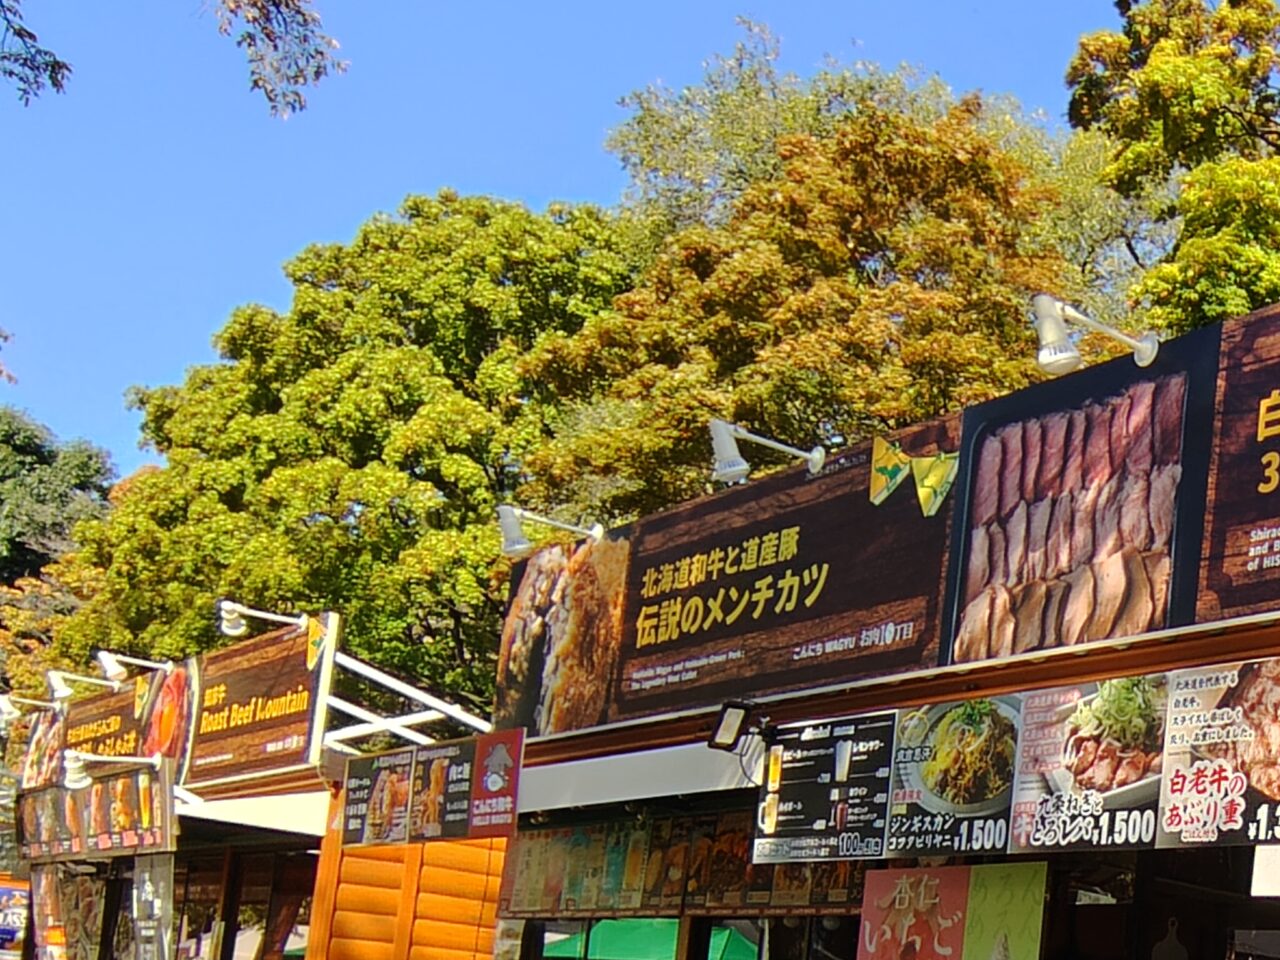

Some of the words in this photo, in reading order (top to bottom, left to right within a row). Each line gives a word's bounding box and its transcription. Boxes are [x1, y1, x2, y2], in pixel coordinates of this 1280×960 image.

[640, 525, 801, 600] 北海道和牛と道産豚
[1247, 558, 1260, 573] of
[1248, 542, 1269, 558] and
[634, 562, 831, 651] 伝説のメンチカツ
[229, 696, 257, 728] Beef
[1168, 764, 1247, 797] 白老牛の
[889, 812, 956, 834] ジンギスカン
[1093, 809, 1157, 847] ¥1,500
[1163, 798, 1244, 833] あぶり重
[952, 817, 1008, 852] ¥1,500
[892, 873, 941, 910] 杏仁
